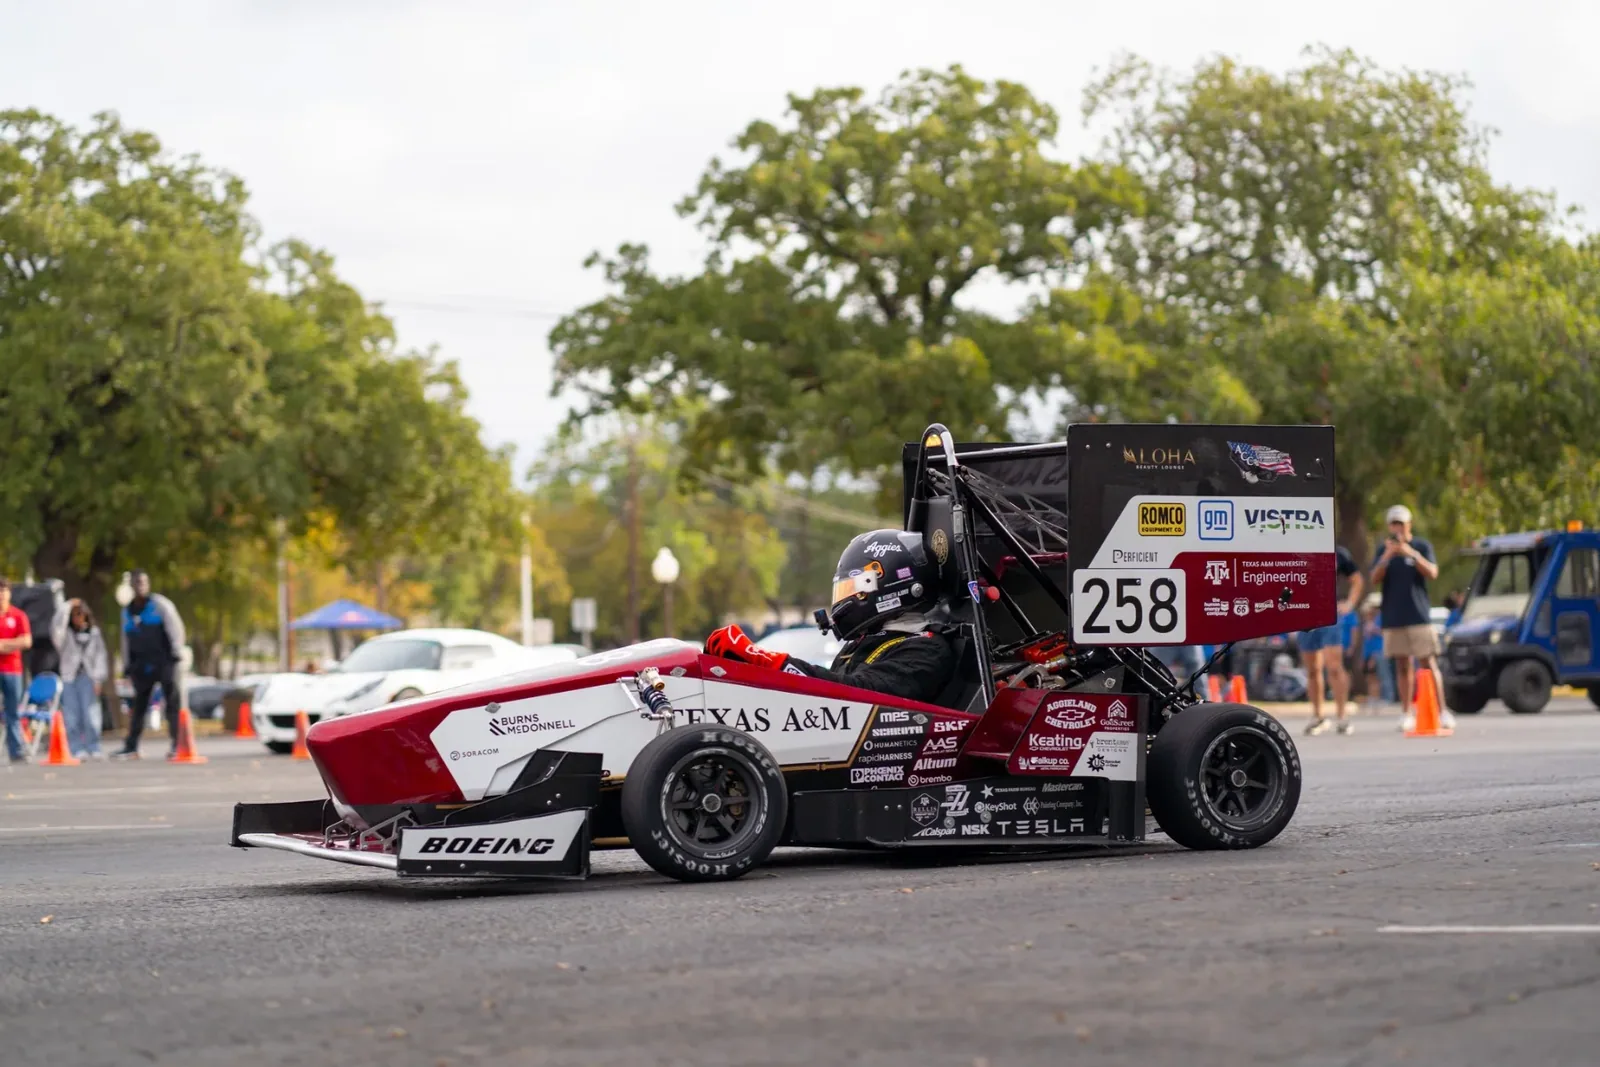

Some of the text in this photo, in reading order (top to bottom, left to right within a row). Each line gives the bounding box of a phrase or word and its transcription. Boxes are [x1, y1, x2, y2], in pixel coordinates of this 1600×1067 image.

[1141, 506, 1183, 525] ROMCO
[1244, 509, 1325, 530] VISTRA
[864, 541, 902, 557] Aggies
[1243, 571, 1307, 585] Engineering
[1081, 577, 1178, 633] 258
[1046, 699, 1097, 712] AGGIELAND
[501, 714, 539, 726] BURNS
[782, 706, 851, 732] A&M
[1044, 715, 1096, 730] CHEVROLET
[934, 720, 970, 732] SKF
[873, 740, 918, 749] HUMANETICS
[922, 737, 958, 751] AAS
[461, 748, 500, 758] SORACOM
[858, 752, 913, 763] rapidHARNESS
[913, 758, 957, 771] Altium
[863, 773, 904, 782] CONTACT
[920, 775, 952, 784] brembo
[985, 802, 1017, 812] KeyShot
[925, 827, 956, 838] Calspan
[961, 825, 991, 836] NSK
[996, 818, 1084, 836] TESLA
[418, 838, 555, 855] BOEING
